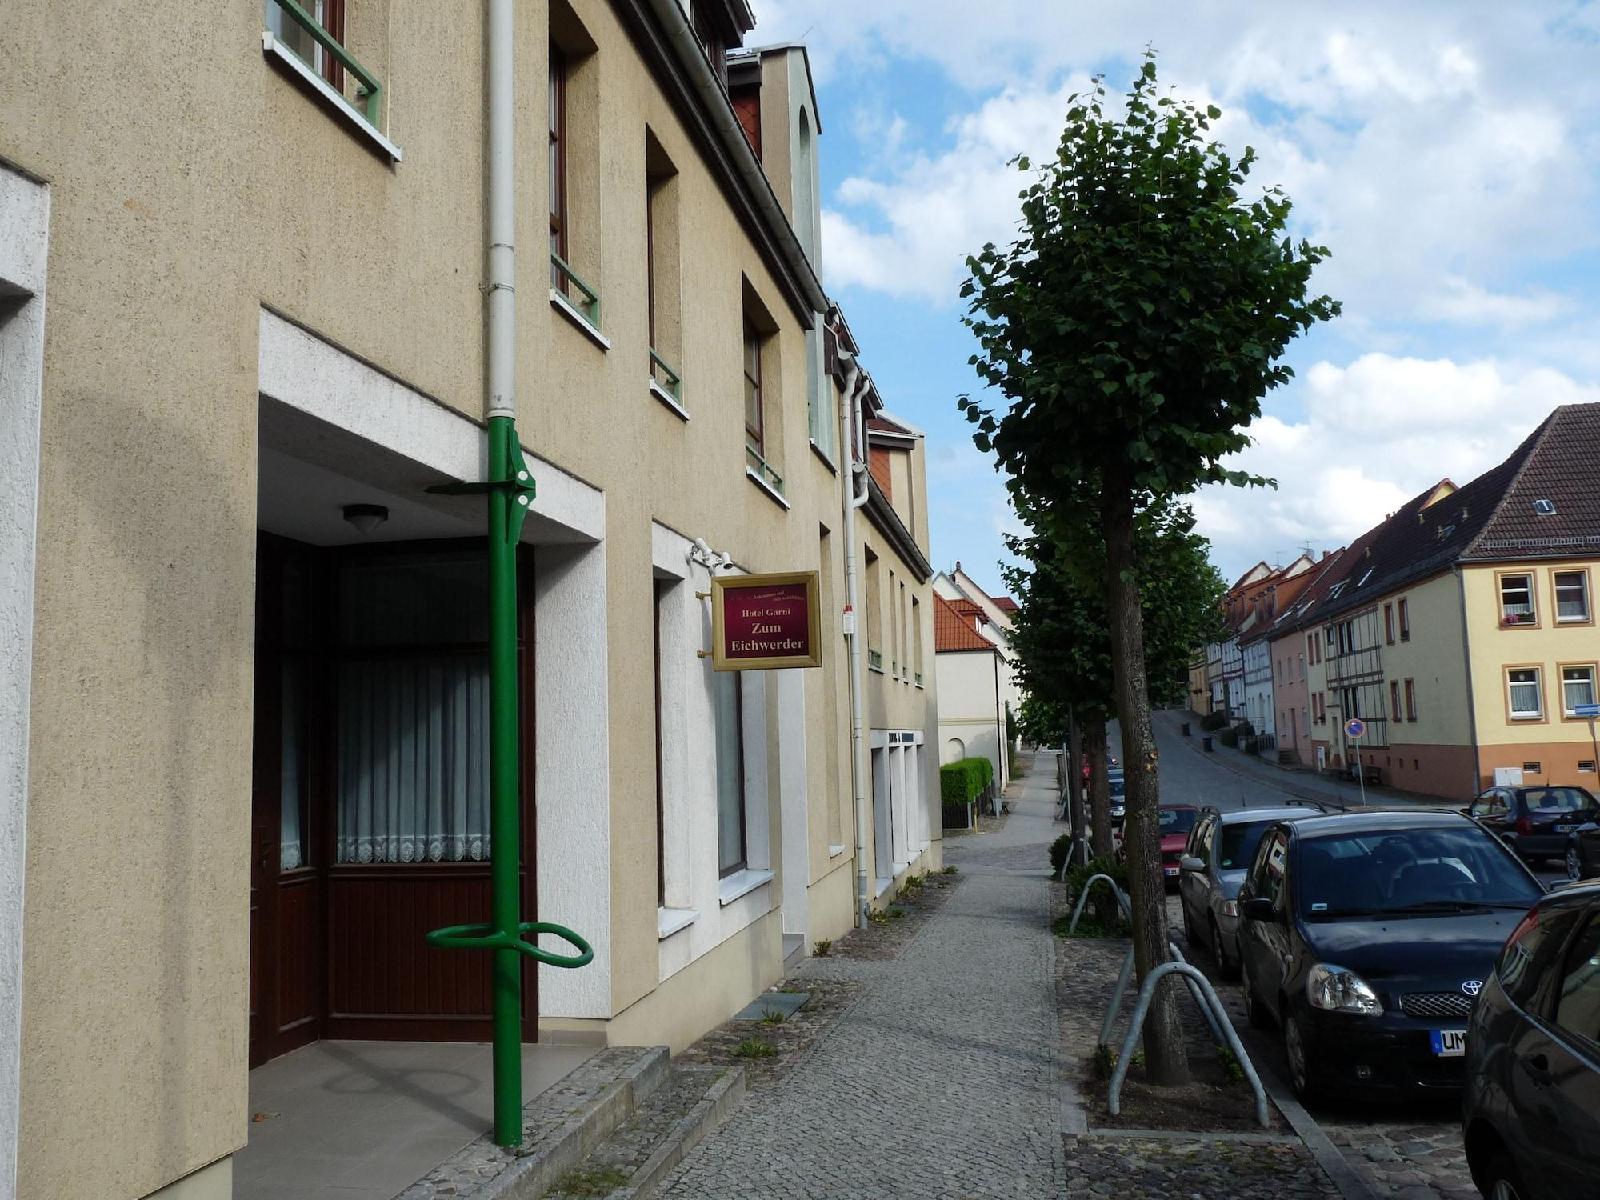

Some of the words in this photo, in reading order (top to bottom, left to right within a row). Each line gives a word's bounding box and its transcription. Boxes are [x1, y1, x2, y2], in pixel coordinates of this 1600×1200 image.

[741, 608, 764, 618] Hotel
[765, 607, 791, 617] Garni
[751, 622, 782, 634] Zum
[731, 638, 804, 651] Eichwerder
